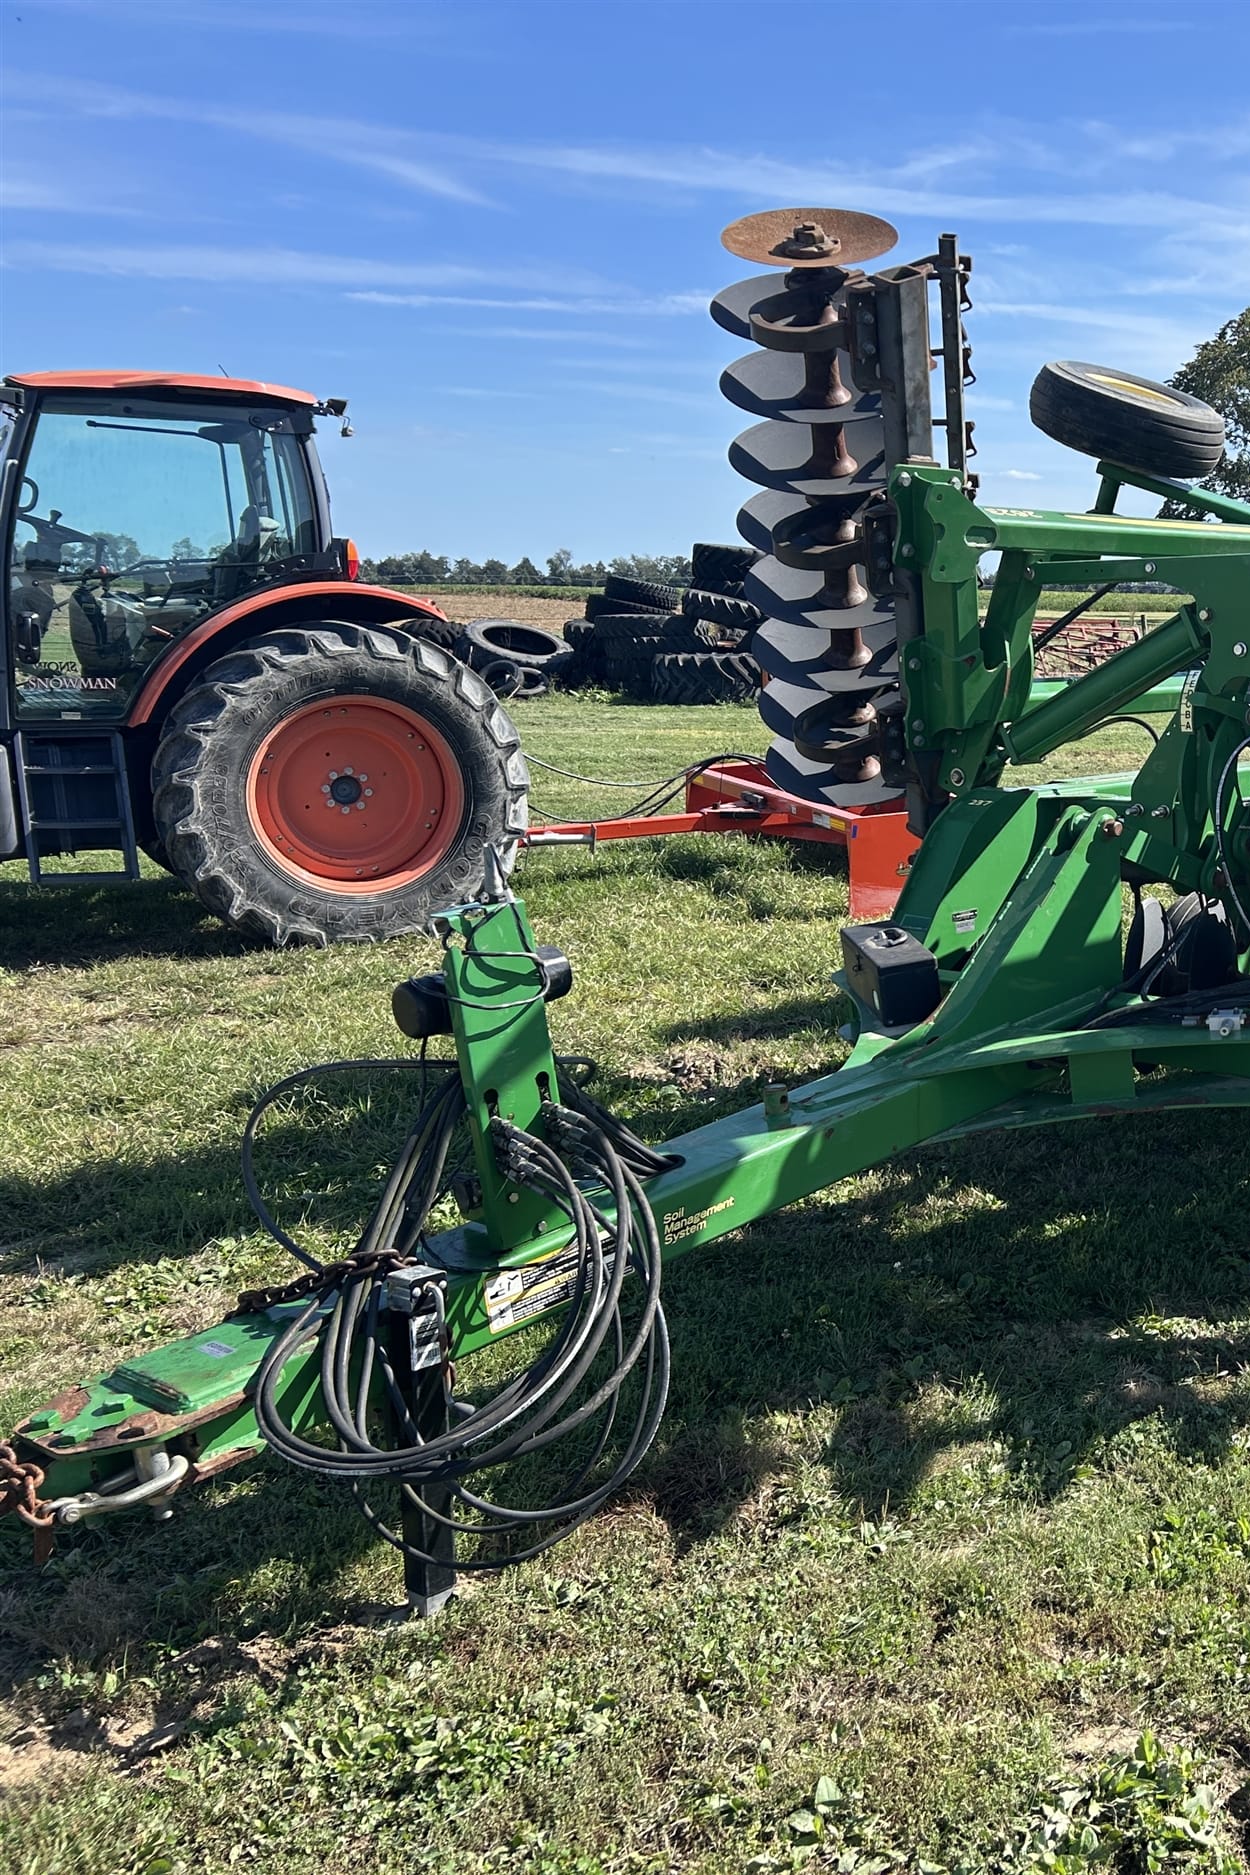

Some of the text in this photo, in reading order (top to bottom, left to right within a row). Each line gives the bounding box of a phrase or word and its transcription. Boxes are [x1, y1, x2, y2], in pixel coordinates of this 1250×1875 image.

[28, 677, 118, 690] SNOWMAN
[1189, 680, 1197, 688] E
[1185, 710, 1191, 719] B
[1185, 721, 1192, 730] A
[663, 1206, 685, 1224] Soil
[664, 1195, 736, 1235] Management
[664, 1219, 708, 1245] System
